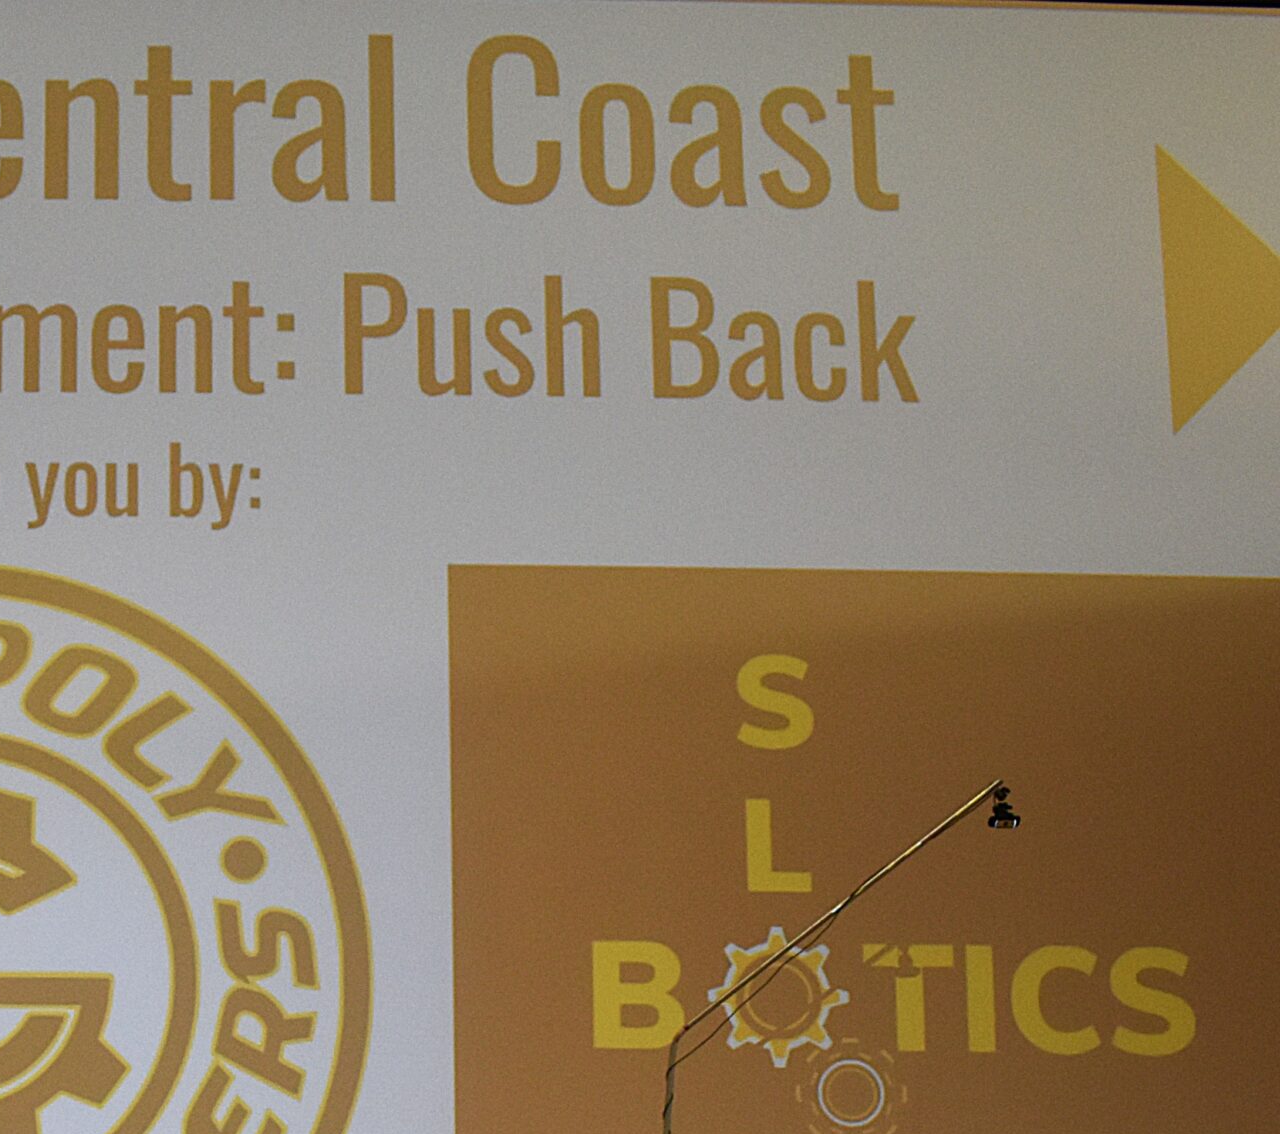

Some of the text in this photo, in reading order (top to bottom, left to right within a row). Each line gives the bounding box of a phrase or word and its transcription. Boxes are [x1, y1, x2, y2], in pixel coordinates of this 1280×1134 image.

[466, 34, 900, 212] Coast
[343, 272, 601, 398] Push
[650, 276, 920, 403] Back
[25, 461, 139, 529] you
[168, 442, 262, 530] by:
